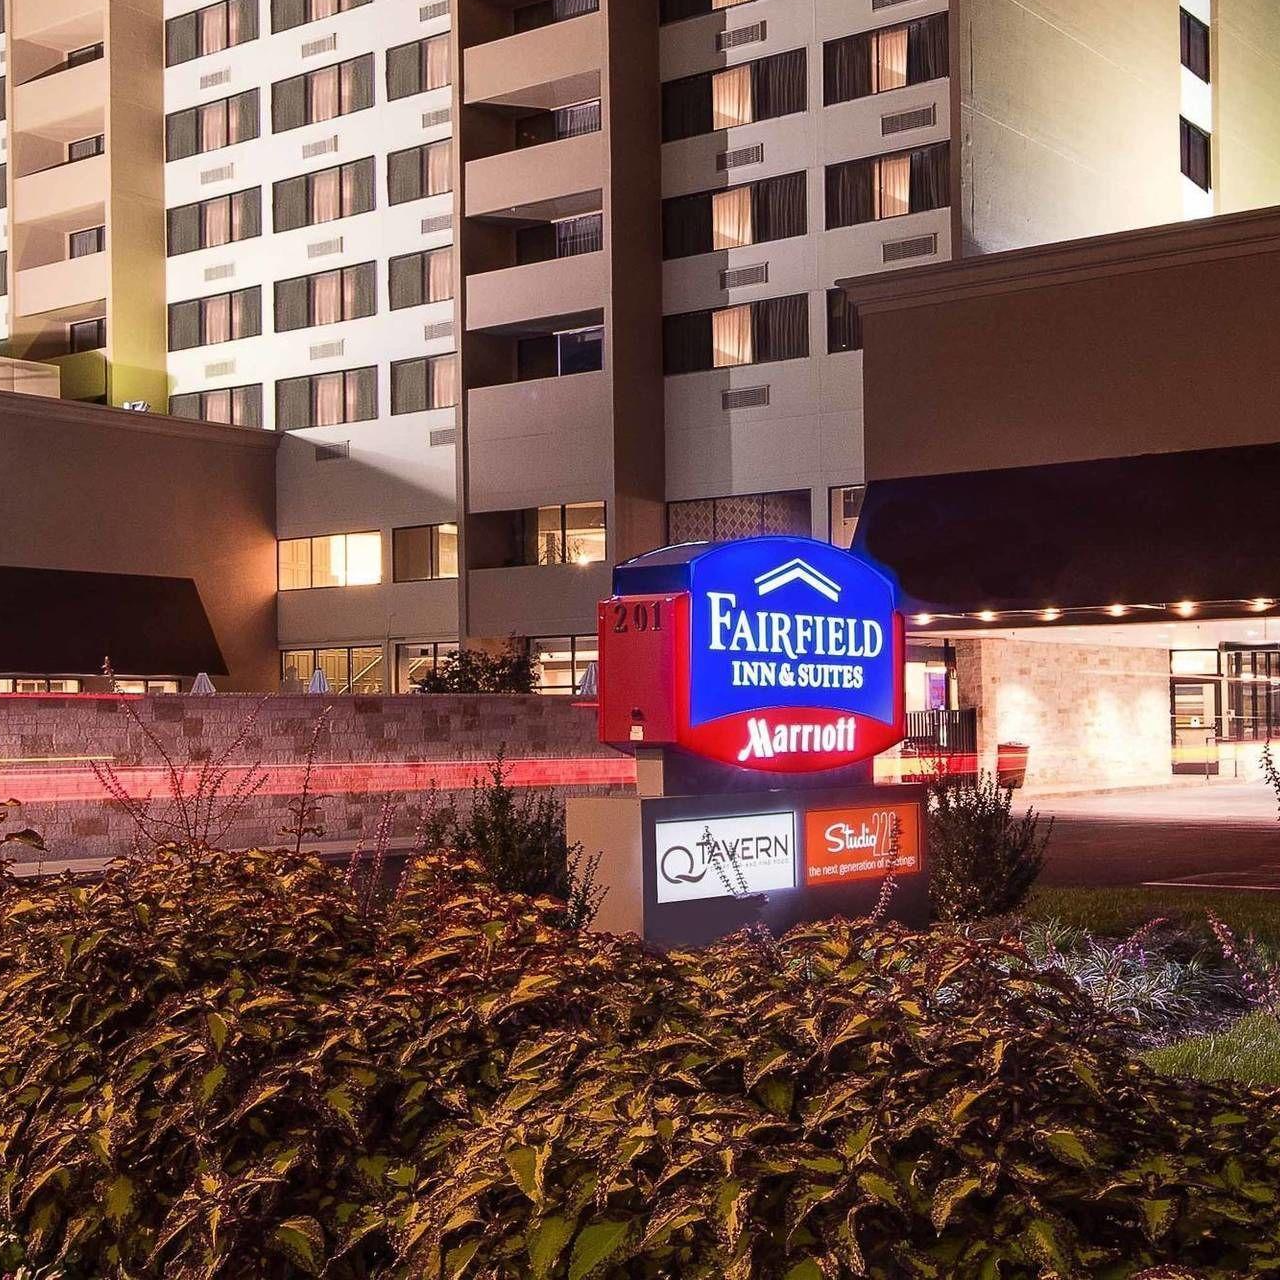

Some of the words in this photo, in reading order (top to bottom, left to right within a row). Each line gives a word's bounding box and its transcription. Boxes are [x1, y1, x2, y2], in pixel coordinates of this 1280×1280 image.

[612, 601, 662, 633] 201
[706, 591, 883, 659] FAIRFIELD
[731, 660, 776, 687] INN
[778, 661, 796, 687] &
[797, 662, 863, 689] SUITES
[737, 716, 856, 762] Marriott
[696, 833, 789, 865] TAVERN
[824, 822, 876, 853] Studio
[809, 865, 821, 877] the
[822, 863, 838, 875] next
[839, 859, 877, 876] generation
[877, 857, 885, 869] of
